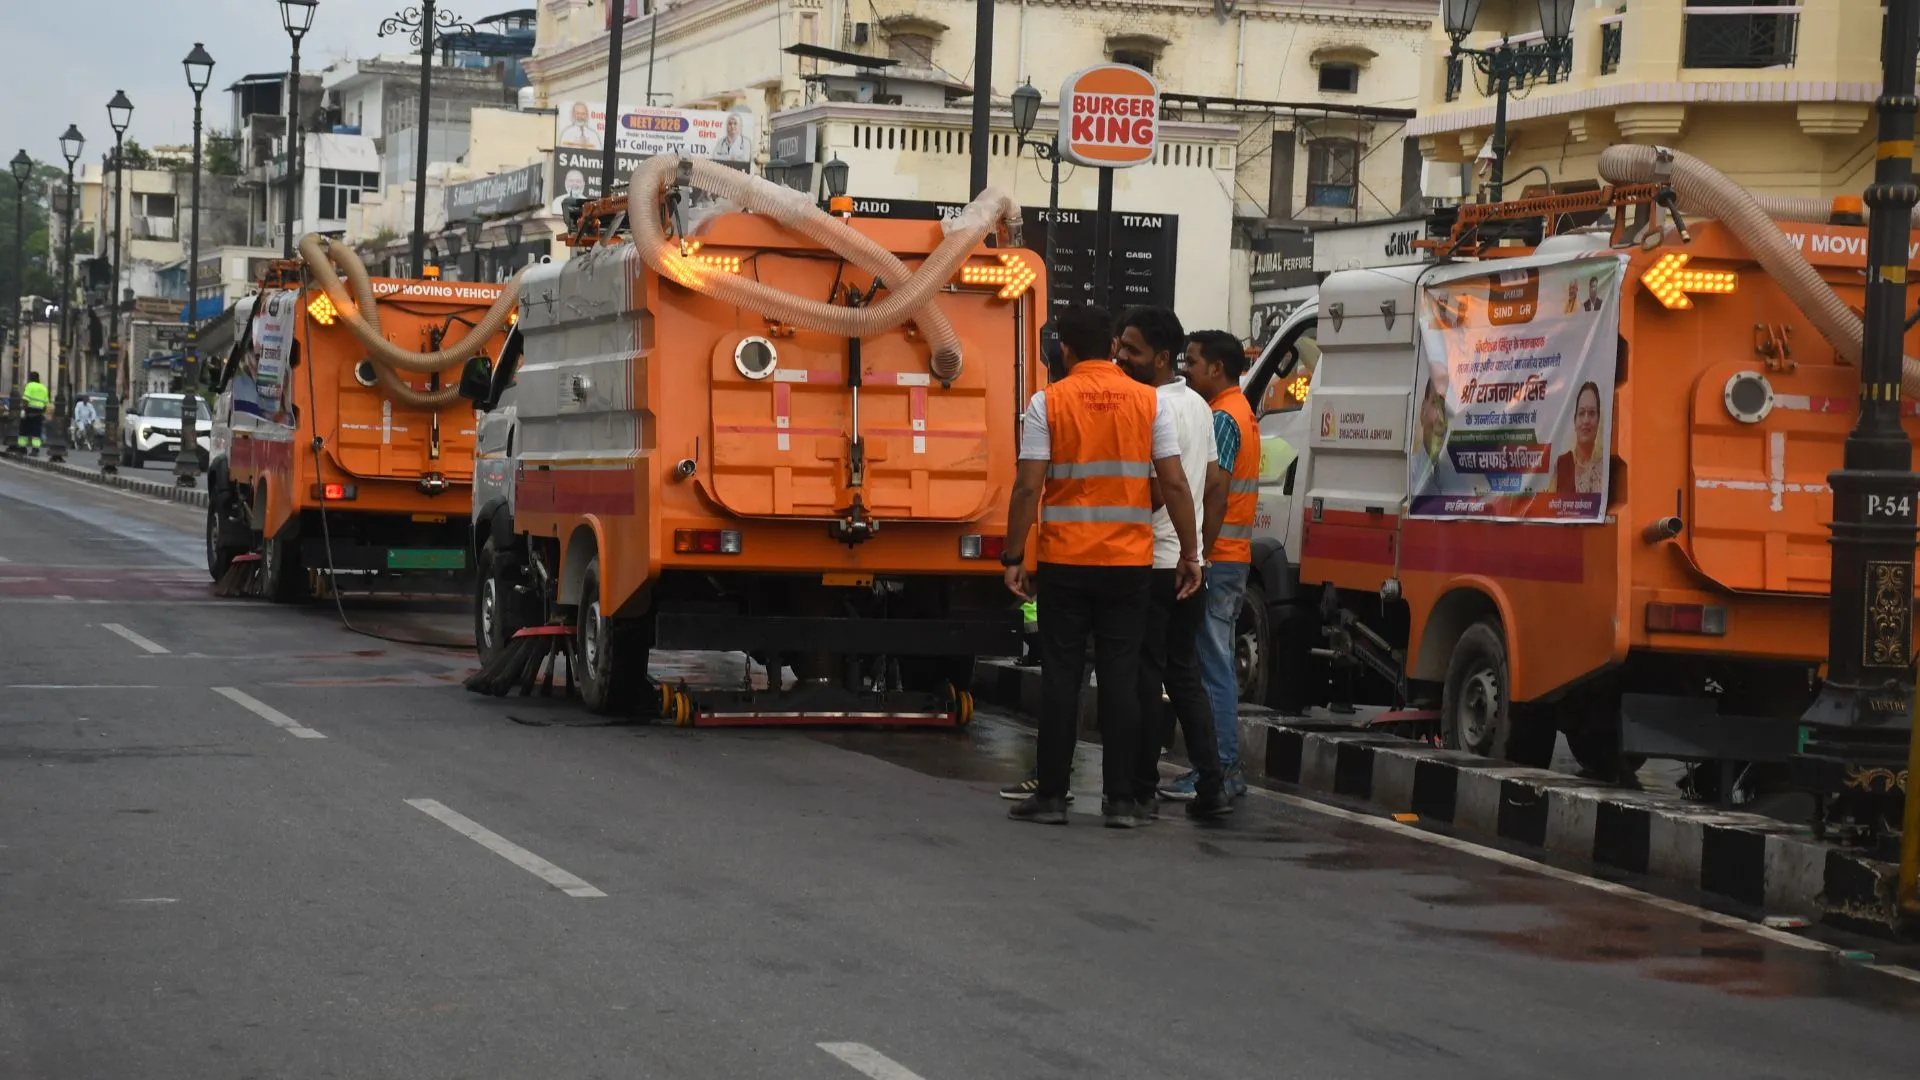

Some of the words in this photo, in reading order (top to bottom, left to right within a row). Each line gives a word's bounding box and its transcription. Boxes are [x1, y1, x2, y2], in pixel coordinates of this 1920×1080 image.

[1072, 95, 1154, 118] BURGER
[629, 114, 653, 129] NEET
[692, 118, 710, 129] Only
[711, 119, 723, 129] For
[698, 130, 716, 139] Girls
[1071, 114, 1154, 145] KING
[630, 140, 664, 152] College
[690, 143, 710, 155] LTD.
[559, 153, 568, 167] S
[570, 154, 604, 169] Ahm
[936, 205, 962, 217] TISS
[1121, 215, 1162, 228] TITAN
[1811, 233, 1867, 256] MOVI
[1126, 251, 1152, 259] CASIO
[1256, 252, 1282, 274] AJMAL
[1283, 256, 1312, 271] PERFUME
[372, 283, 399, 293] LOW
[402, 285, 453, 297] MOVING
[1125, 285, 1149, 293] FOSSIL
[1493, 306, 1513, 319] SIND
[1461, 378, 1477, 404] श्री
[1476, 382, 1524, 404] राजनाथ
[1524, 373, 1548, 401] सिंह
[1340, 412, 1365, 424] LUCKNOW
[1369, 428, 1393, 441] ABHIYAN
[1457, 450, 1477, 469] महा
[1477, 446, 1508, 470] सफाई
[1867, 494, 1911, 517] P-54
